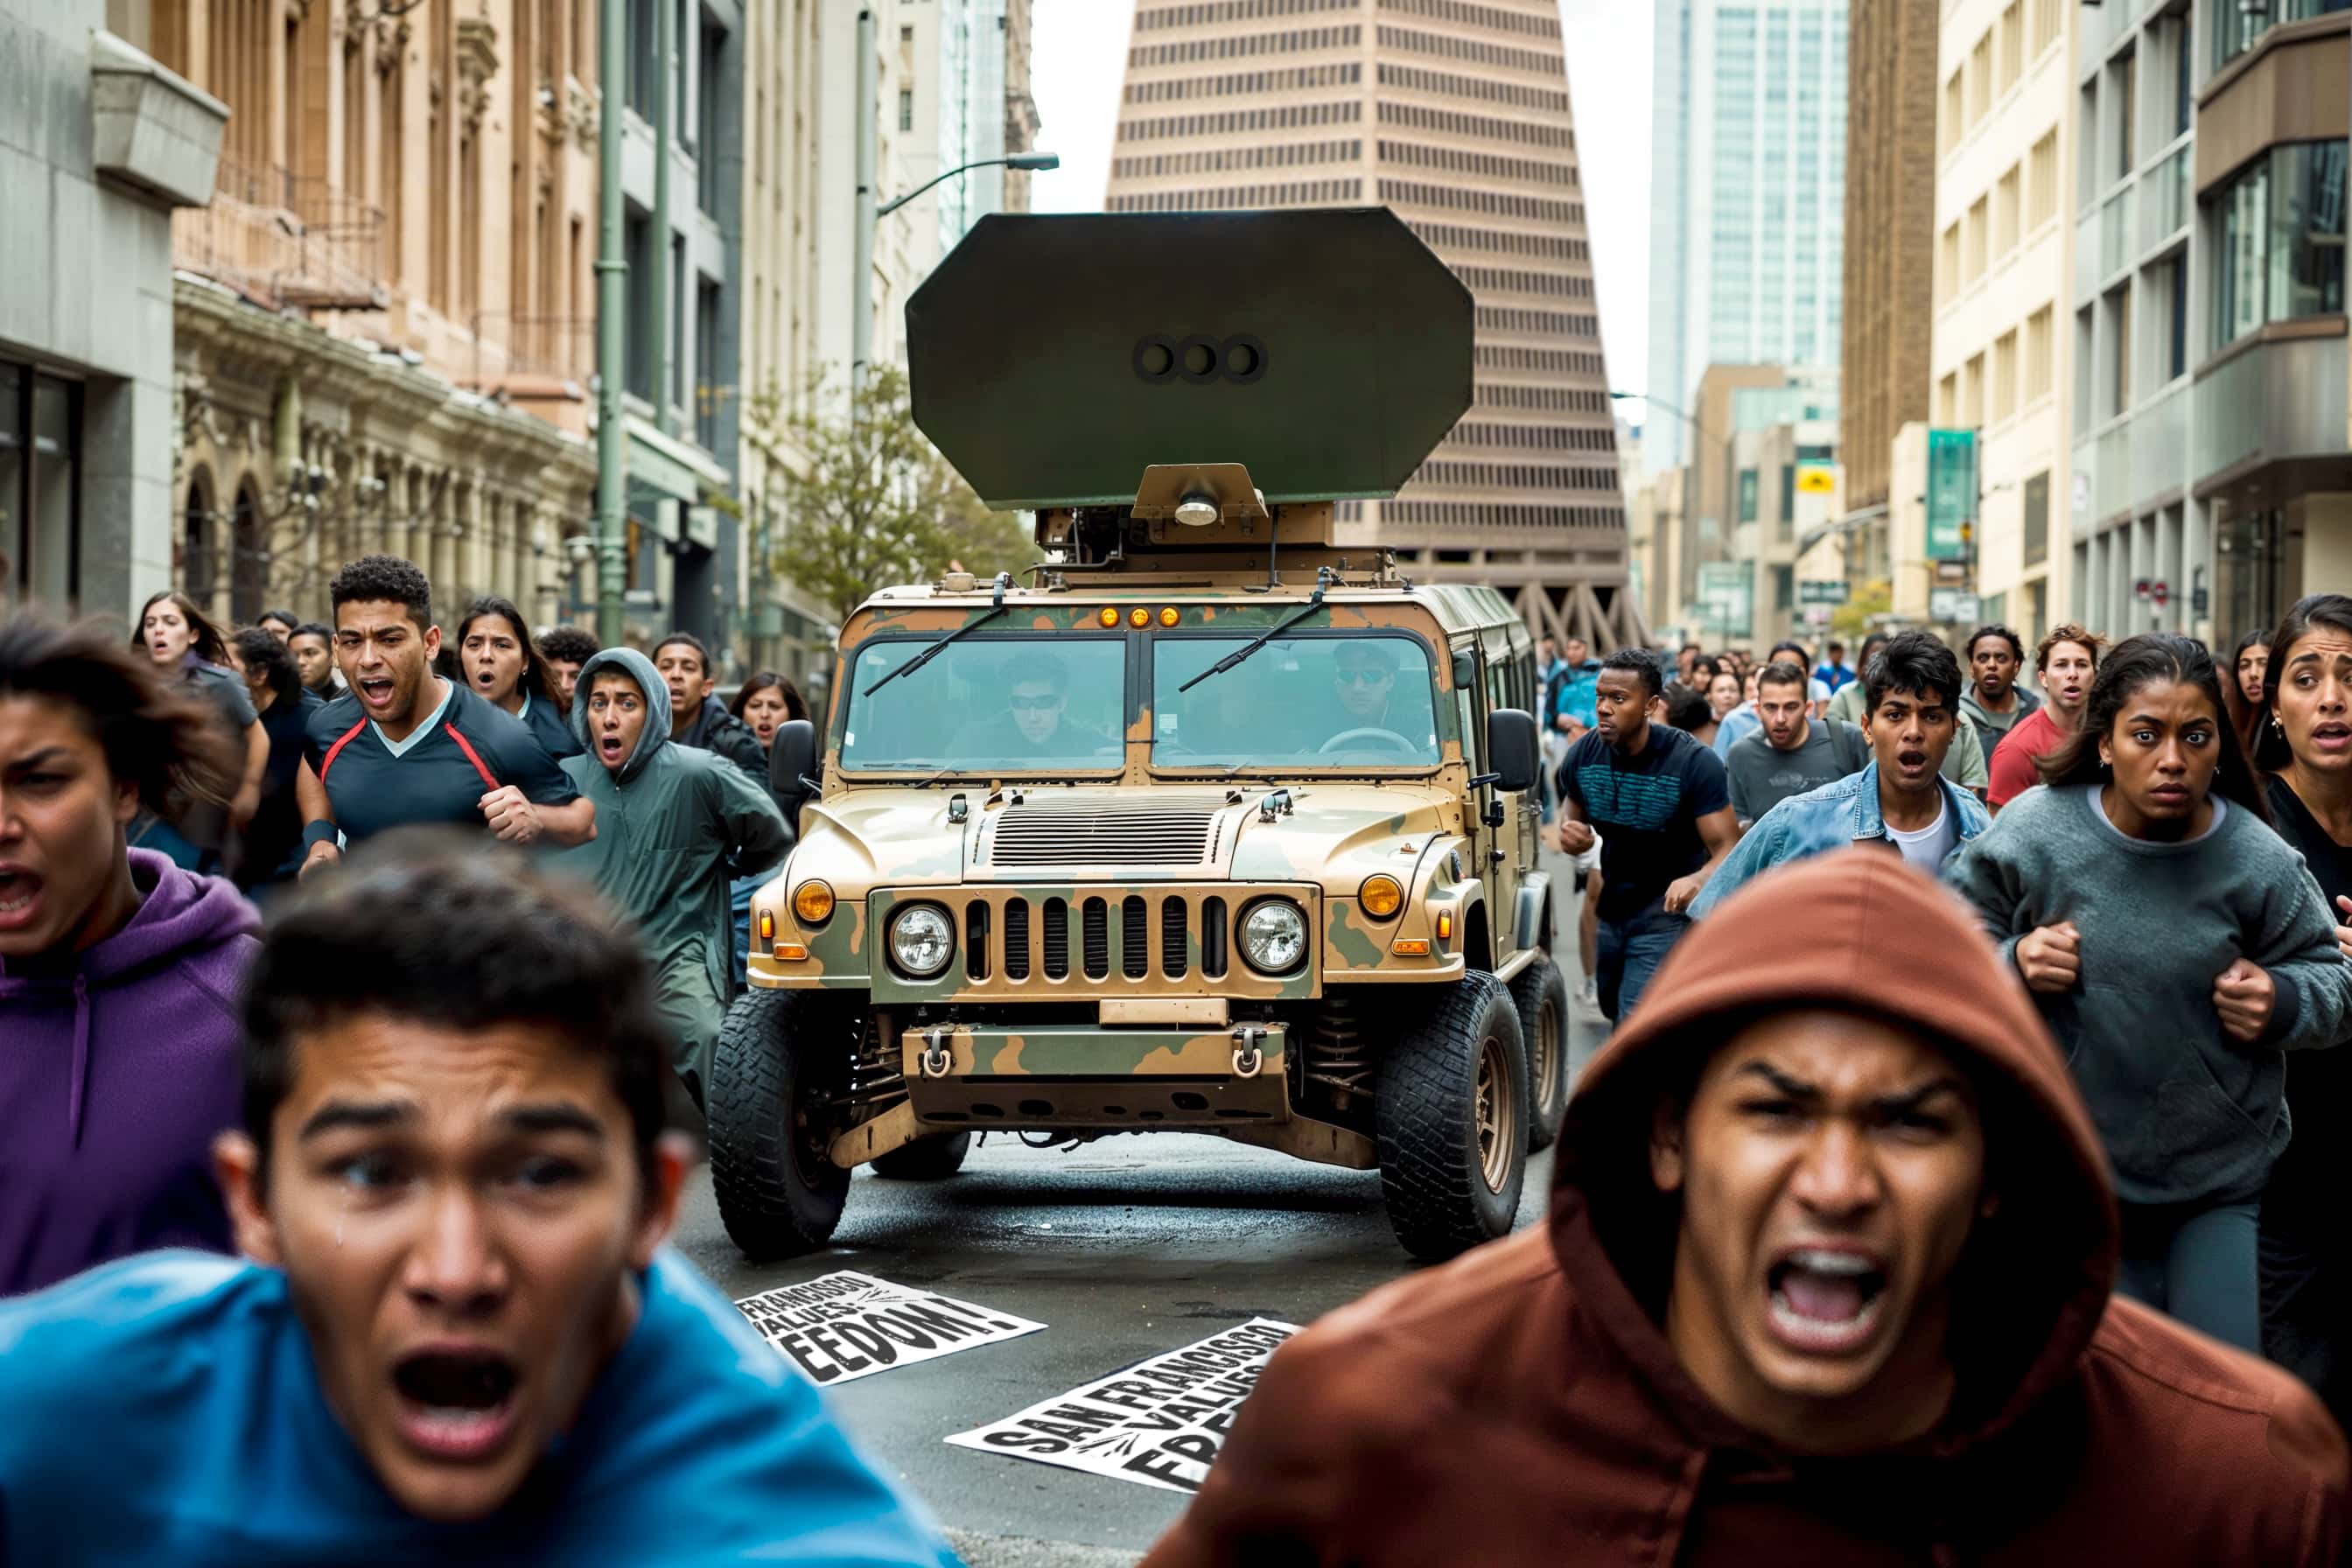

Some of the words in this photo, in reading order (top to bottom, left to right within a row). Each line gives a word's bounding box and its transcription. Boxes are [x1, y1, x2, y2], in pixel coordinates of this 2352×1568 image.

[735, 1276, 874, 1320] FRANCISCO
[983, 1403, 1130, 1454] SAN
[1083, 1325, 1293, 1410] FRANCISCO
